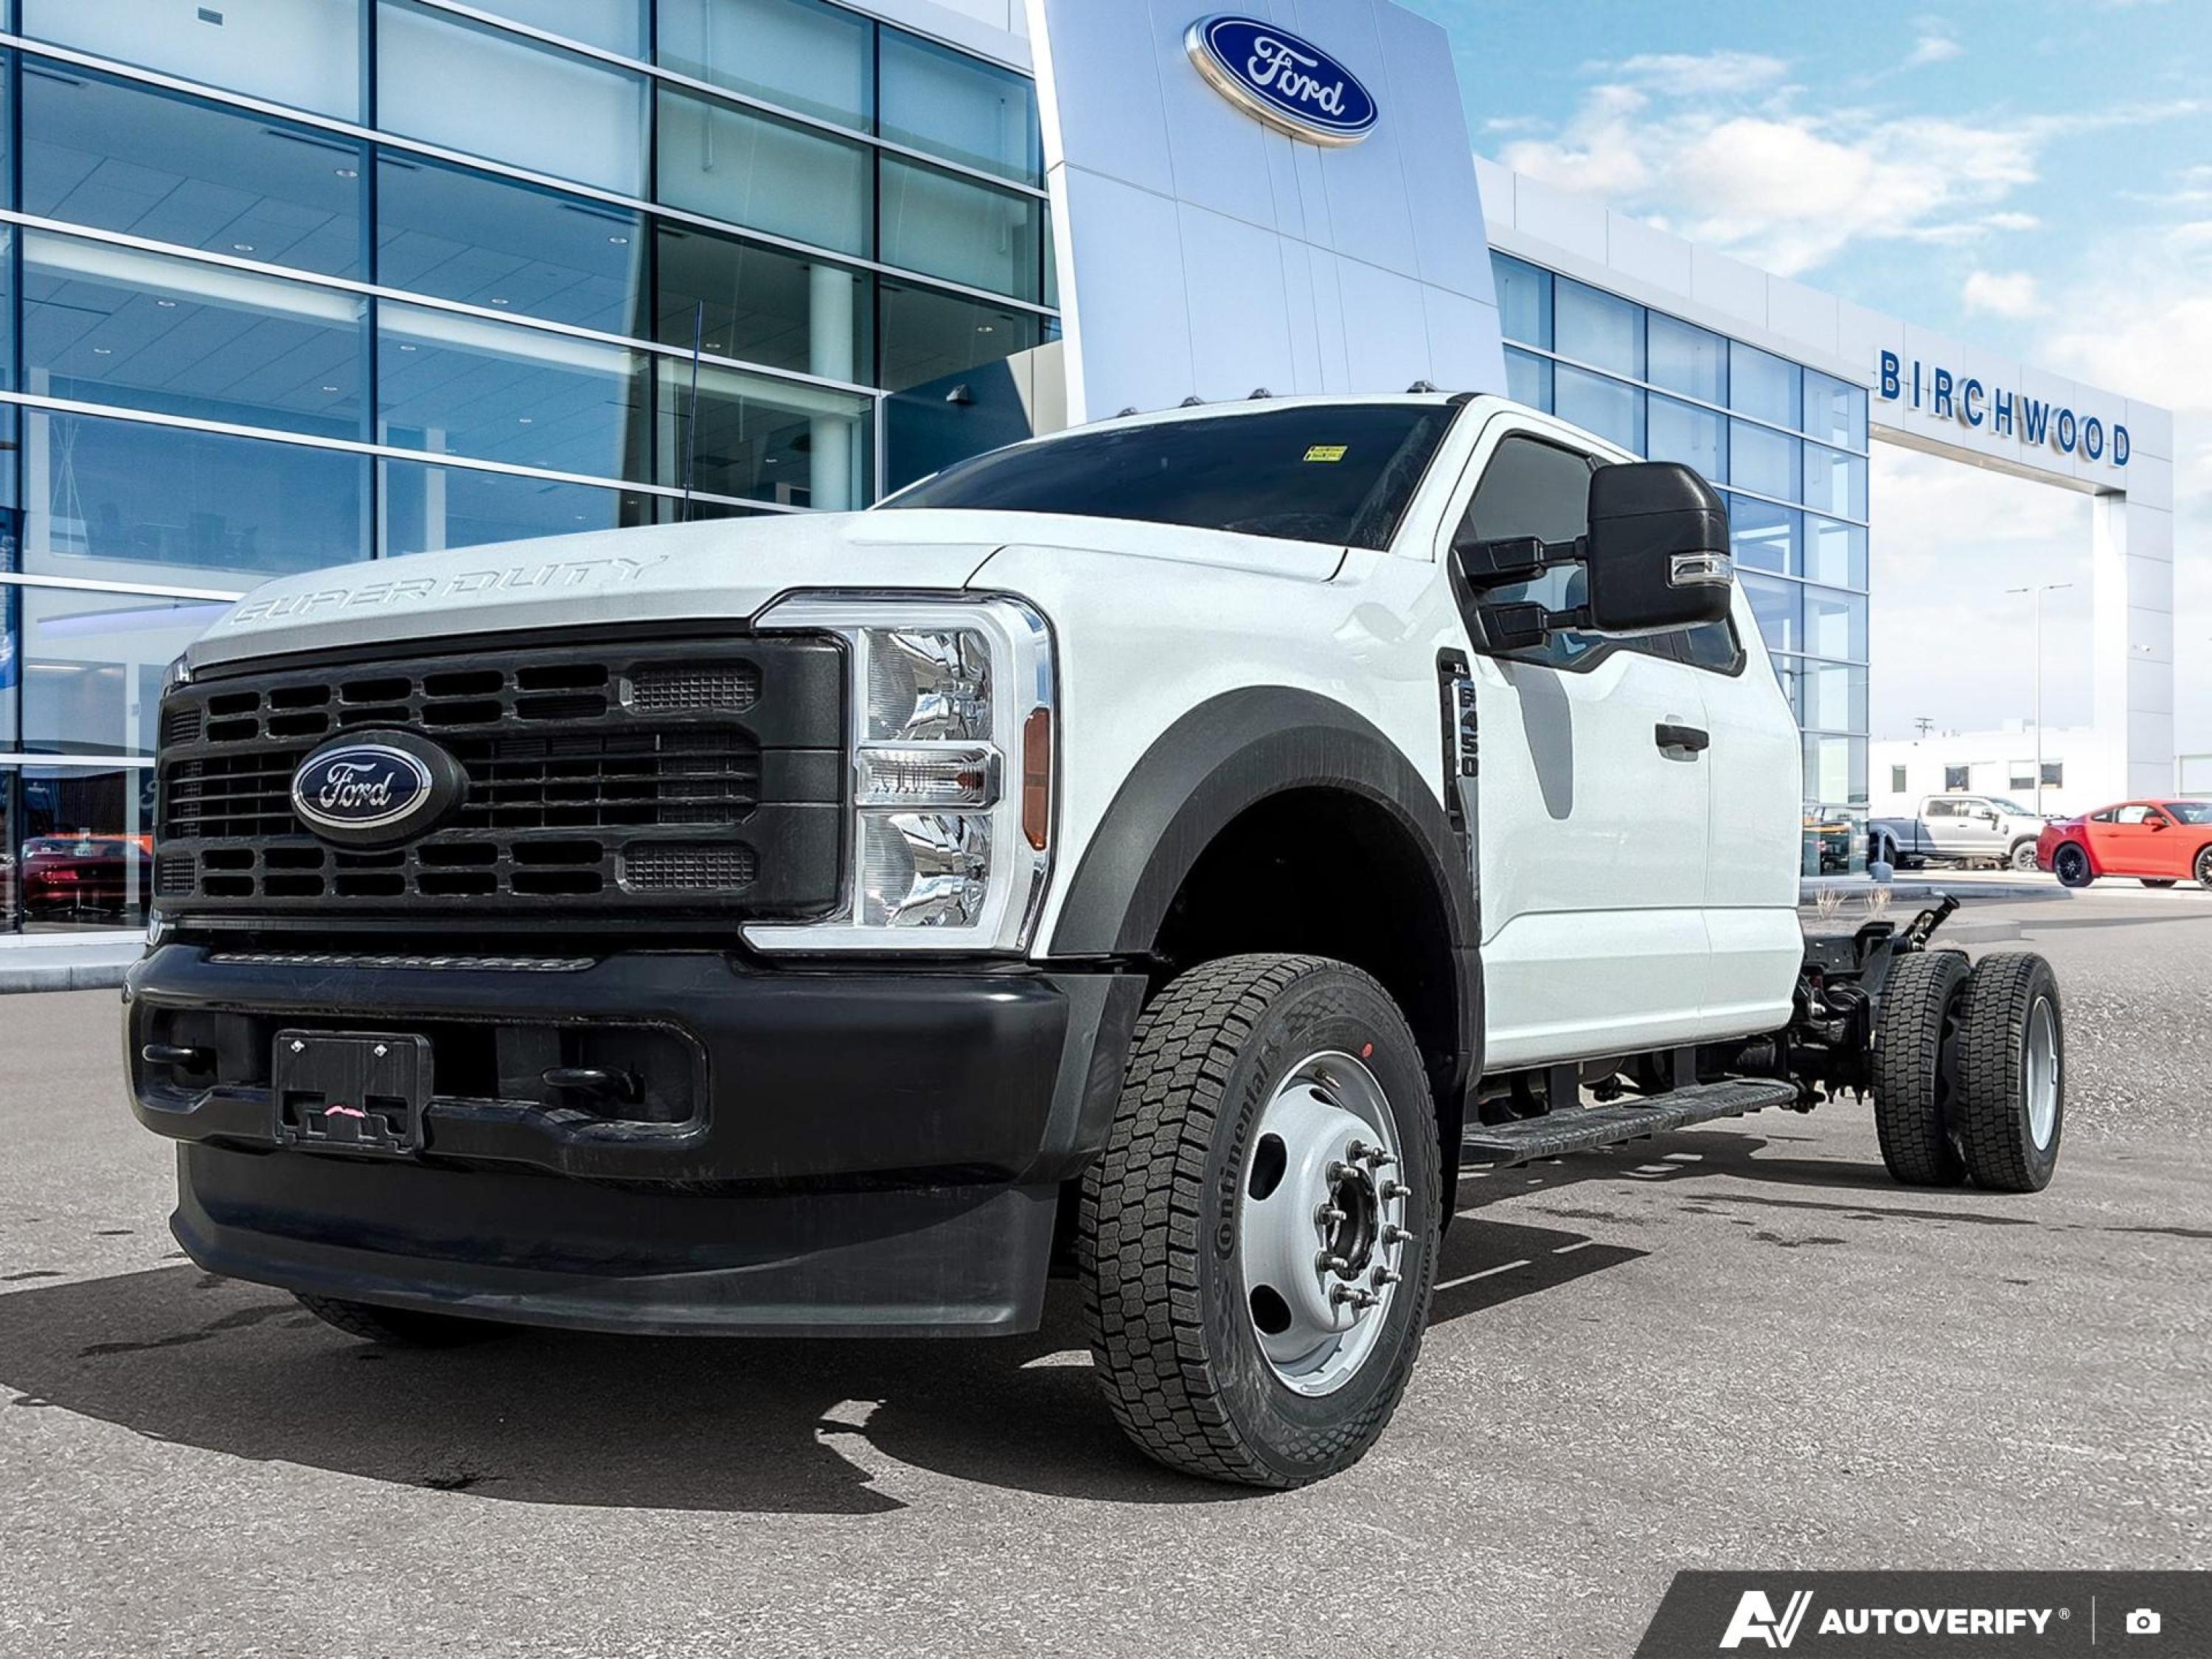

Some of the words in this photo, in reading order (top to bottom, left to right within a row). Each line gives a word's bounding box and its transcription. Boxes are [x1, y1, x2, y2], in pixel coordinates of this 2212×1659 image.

[1248, 37, 1345, 116] Ford
[1881, 350, 2130, 466] BIRCHWOOD
[231, 577, 437, 625] SUPER
[444, 554, 669, 596] DUTY
[319, 762, 395, 808] Ford
[1216, 1054, 1270, 1260] Continental
